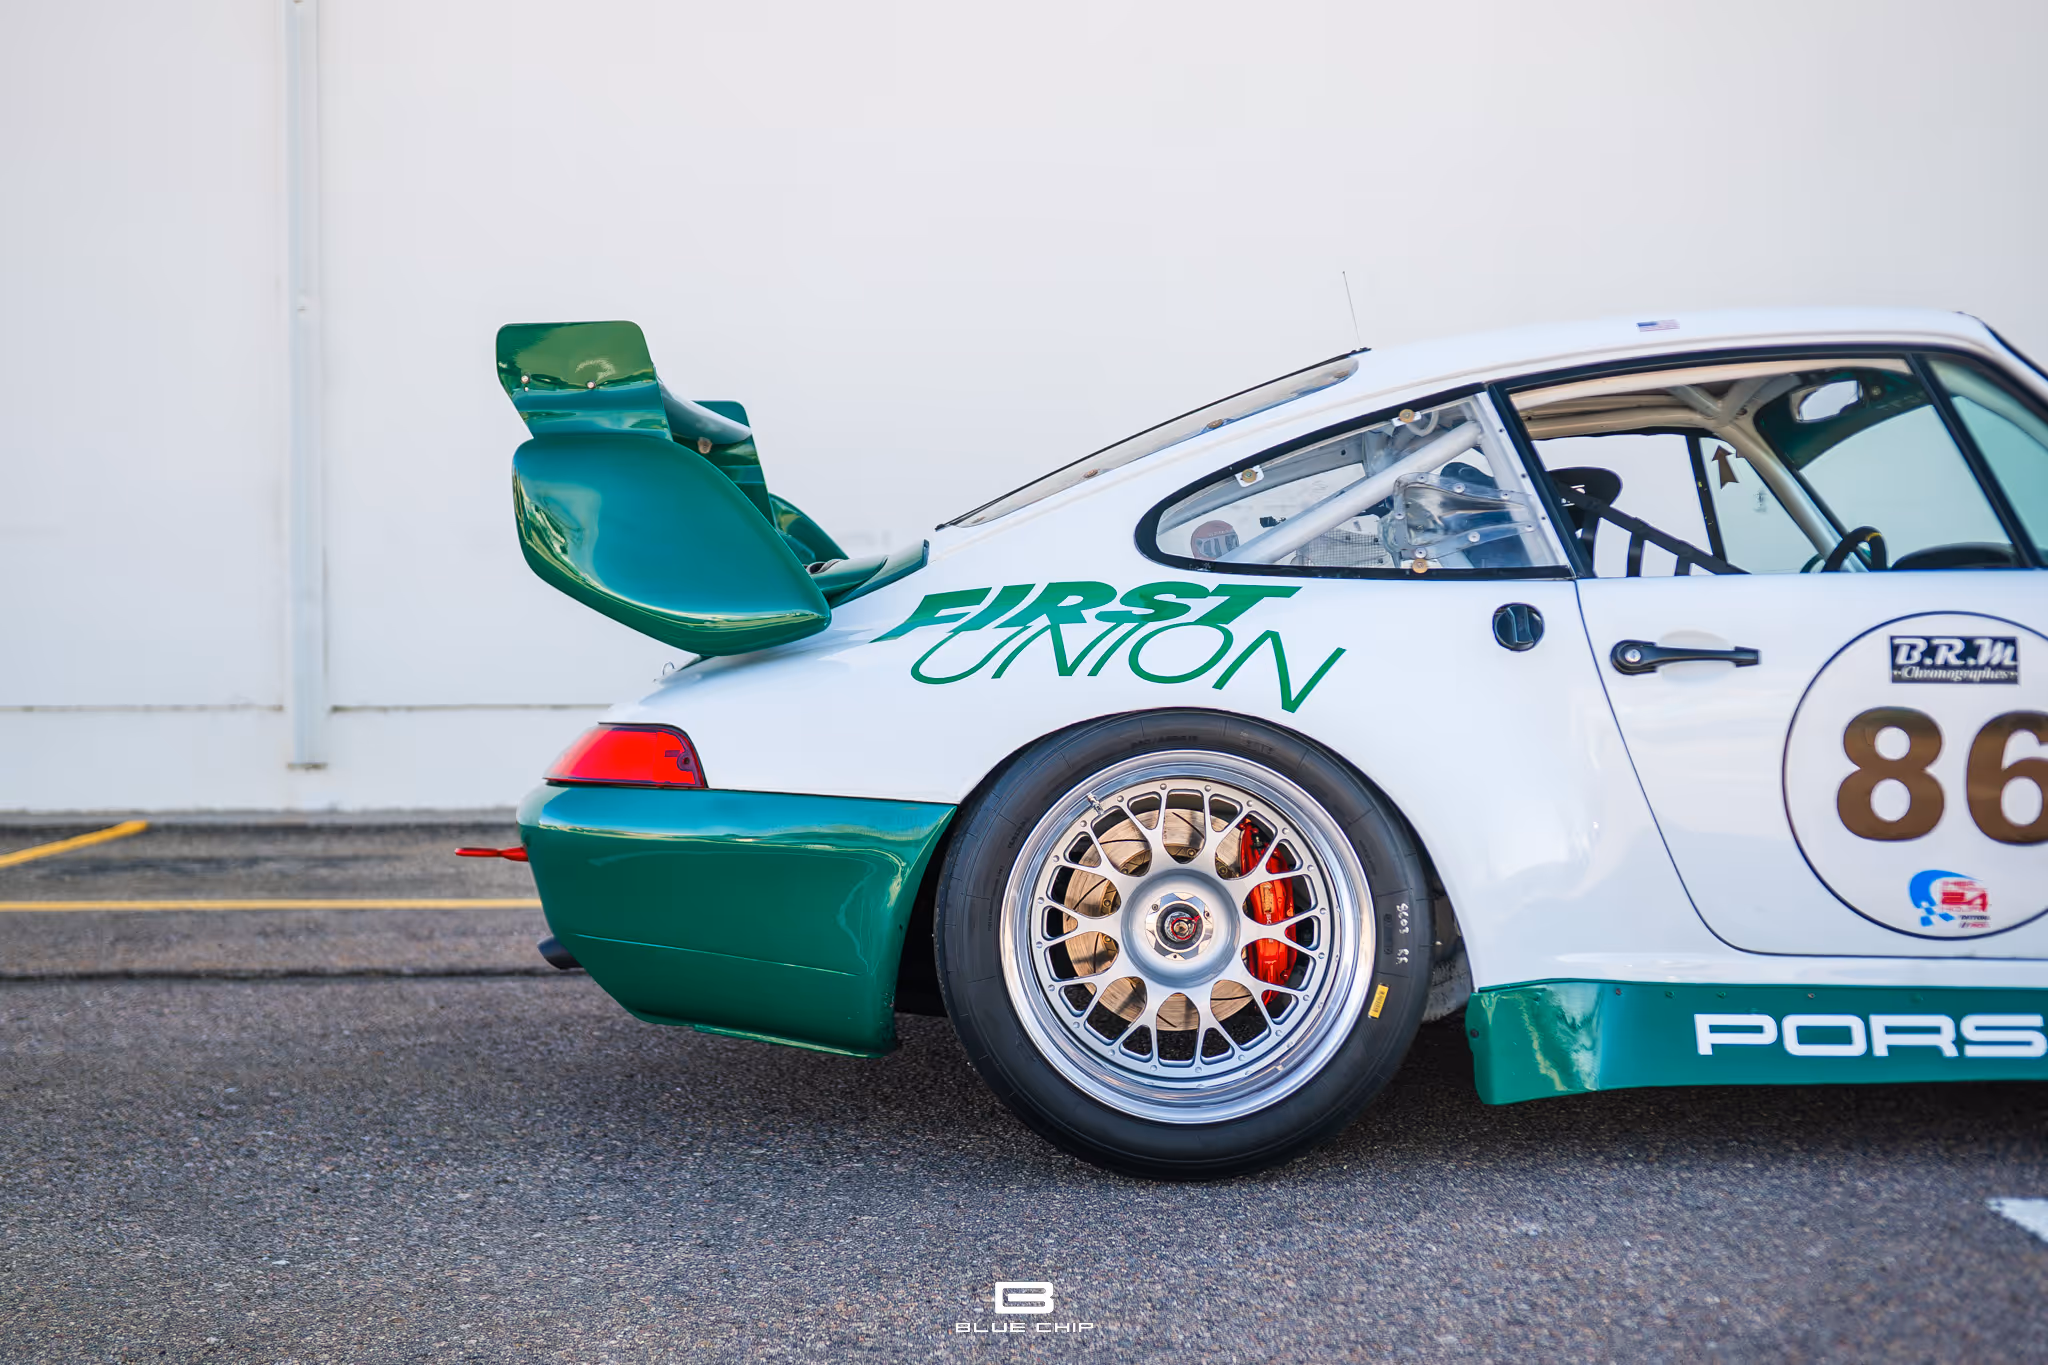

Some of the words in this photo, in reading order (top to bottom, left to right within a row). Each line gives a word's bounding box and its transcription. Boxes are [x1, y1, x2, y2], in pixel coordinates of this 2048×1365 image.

[869, 581, 1303, 643] FIRST
[910, 621, 1347, 713] UNION
[1837, 706, 2048, 846] 86
[1694, 1013, 2048, 1057] PORS
